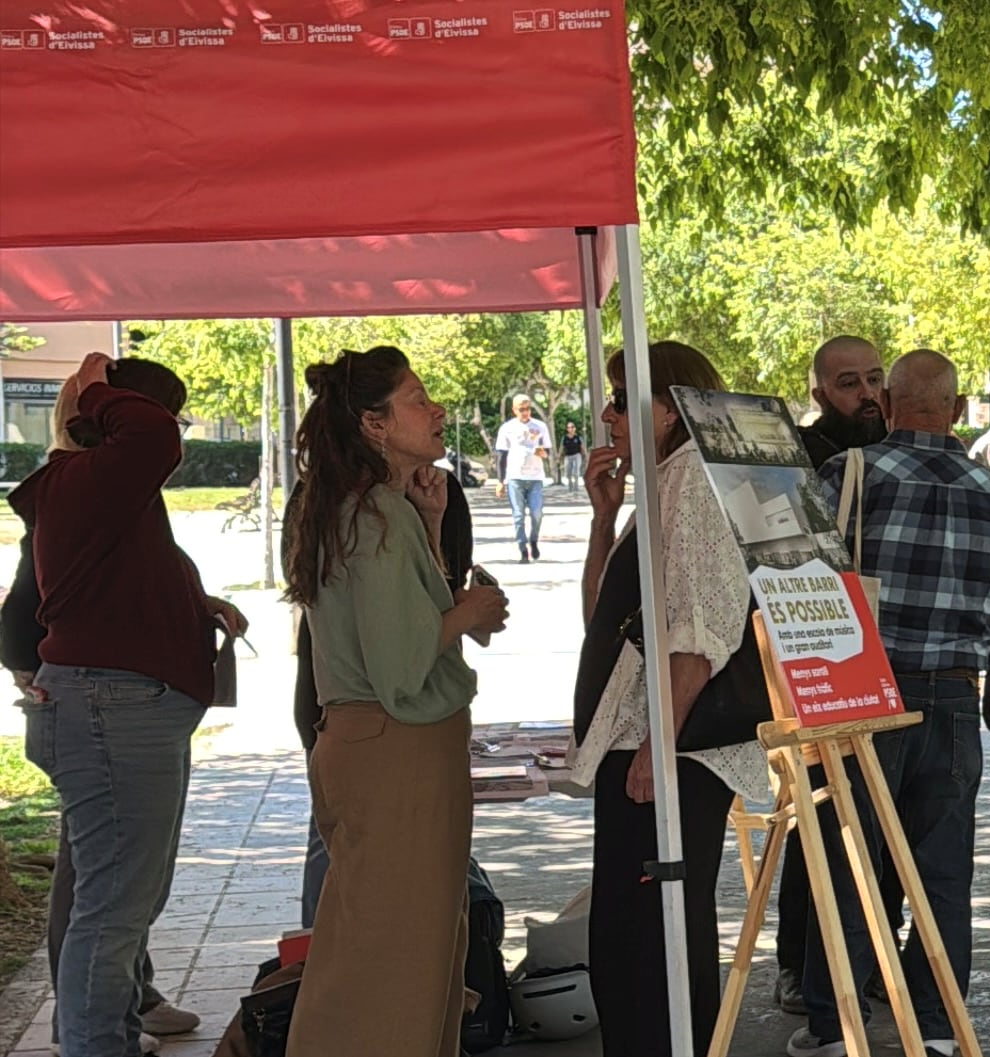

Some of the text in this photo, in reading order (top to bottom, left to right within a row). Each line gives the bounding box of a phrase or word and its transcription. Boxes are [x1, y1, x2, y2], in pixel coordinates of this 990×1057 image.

[558, 9, 611, 20] Socialistes
[434, 17, 488, 29] Socialistes
[558, 20, 603, 30] d'Eivissa
[178, 28, 233, 37] Socialistes
[307, 24, 362, 34] Socialistes
[434, 27, 479, 38] d'Eivissa
[48, 31, 104, 41] Socialistes
[178, 36, 225, 46] d'Eivissa
[307, 33, 353, 43] d'Eivissa
[48, 40, 95, 50] d'Eivissa
[758, 576, 839, 594] UN ALTRE BARRI
[767, 596, 849, 624] ÉS POSSIBLE
